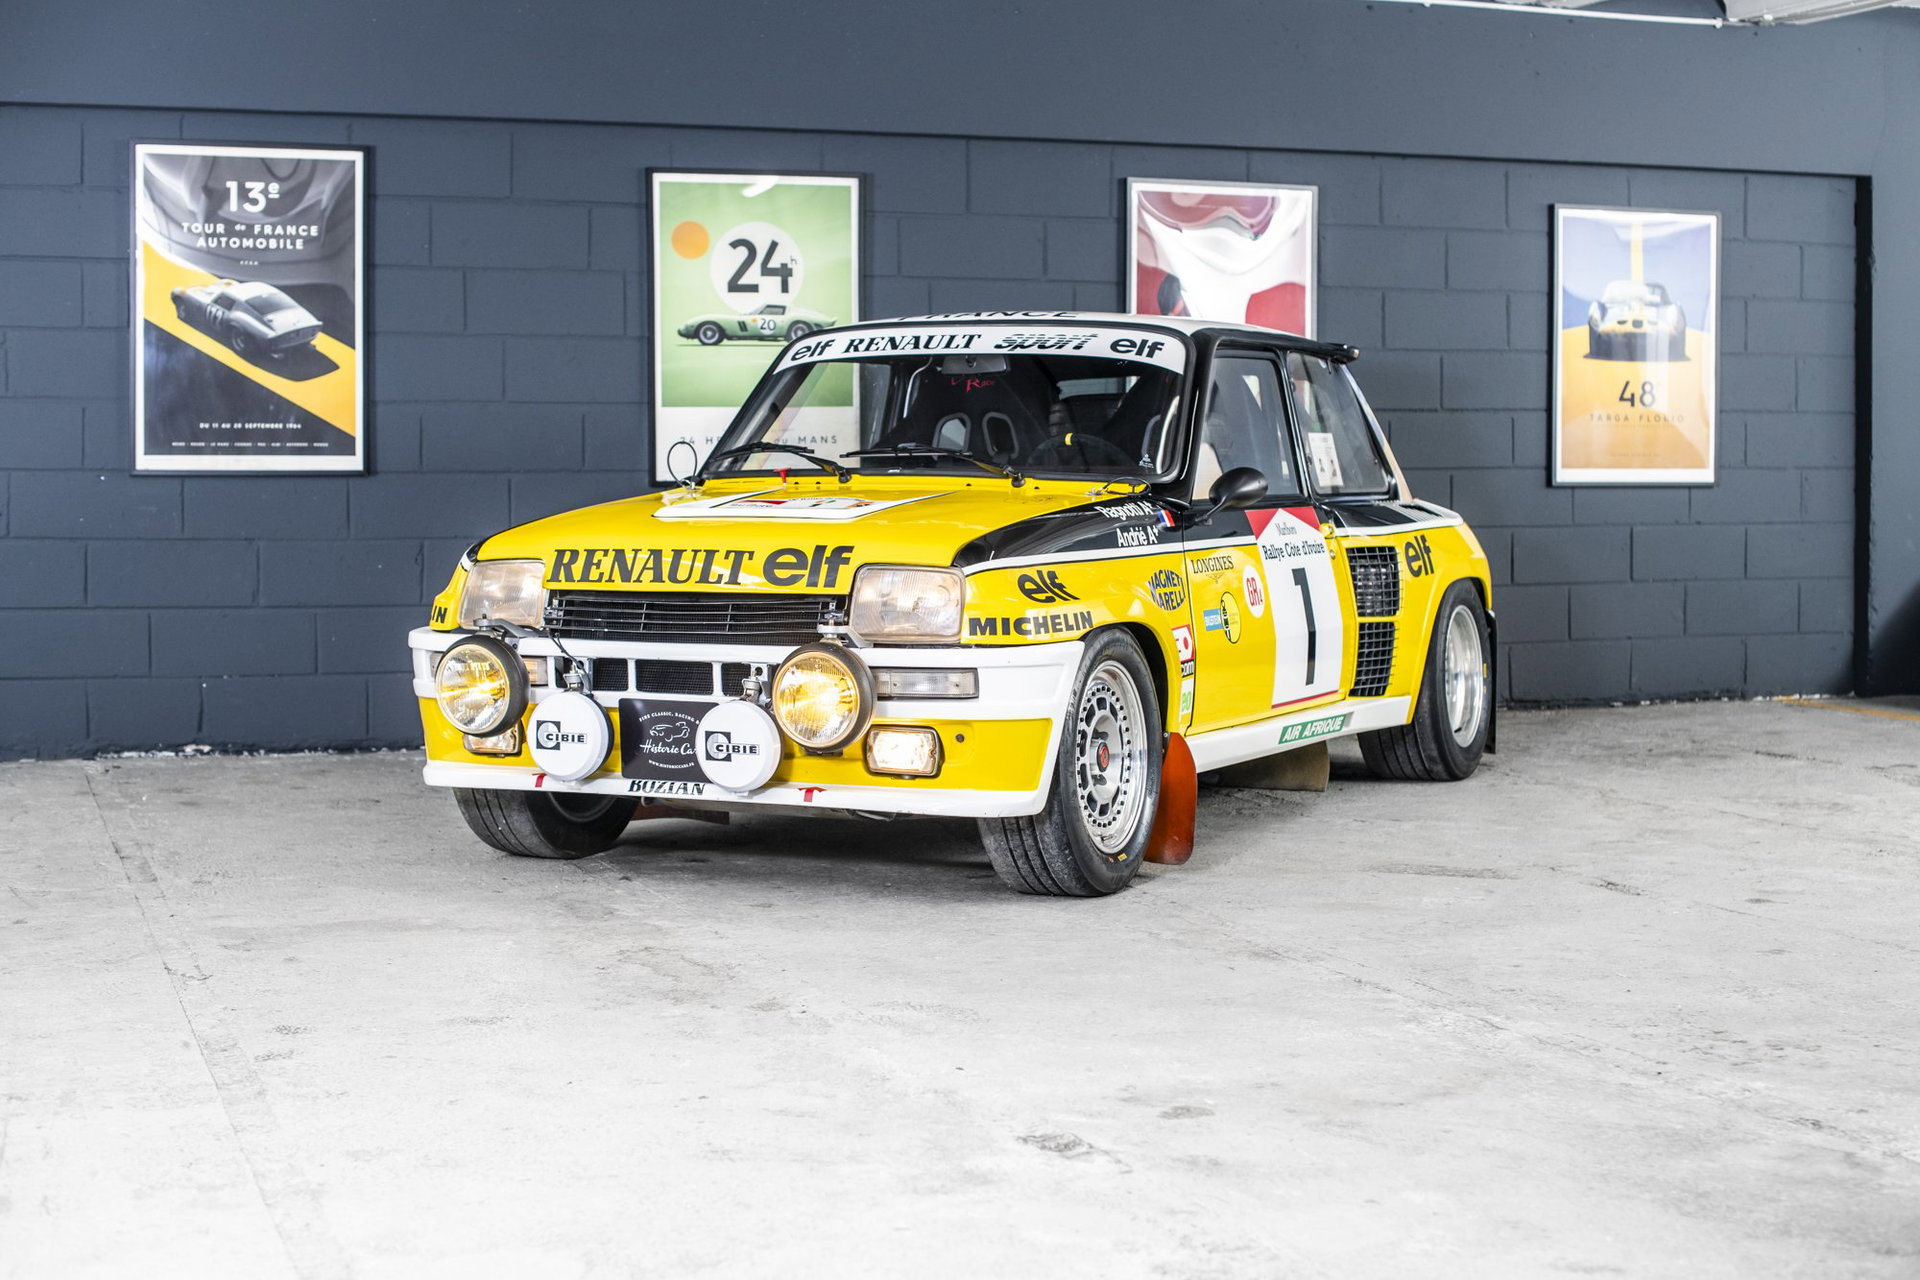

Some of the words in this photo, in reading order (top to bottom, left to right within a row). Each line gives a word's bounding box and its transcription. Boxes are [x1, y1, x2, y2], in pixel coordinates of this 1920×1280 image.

[181, 222, 226, 234] TOUR
[234, 223, 247, 231] de
[253, 224, 319, 236] FRANCE
[196, 237, 304, 250] AUTOMOBILE
[760, 317, 777, 331] 20
[790, 339, 835, 361] elf
[841, 334, 981, 354] RENAULT
[1109, 338, 1165, 358] elf
[1618, 380, 1655, 408] 48
[1590, 414, 1629, 422] TARGA
[798, 435, 838, 444] MANS
[1262, 543, 1285, 561] Rallye
[1405, 534, 1435, 578] elf
[546, 549, 755, 586] RENAULT
[762, 545, 855, 588] elf
[1190, 555, 1235, 574] LONGINES
[1018, 570, 1080, 603] elf
[969, 610, 1095, 637] MICHELIN
[1292, 567, 1317, 686] 1
[675, 712, 695, 722] RACING
[545, 733, 586, 743] CIBIE
[1282, 724, 1303, 742] AIR
[1302, 716, 1345, 738] AFRIQUE
[639, 739, 679, 754] Historic
[715, 744, 758, 755] CIBIE
